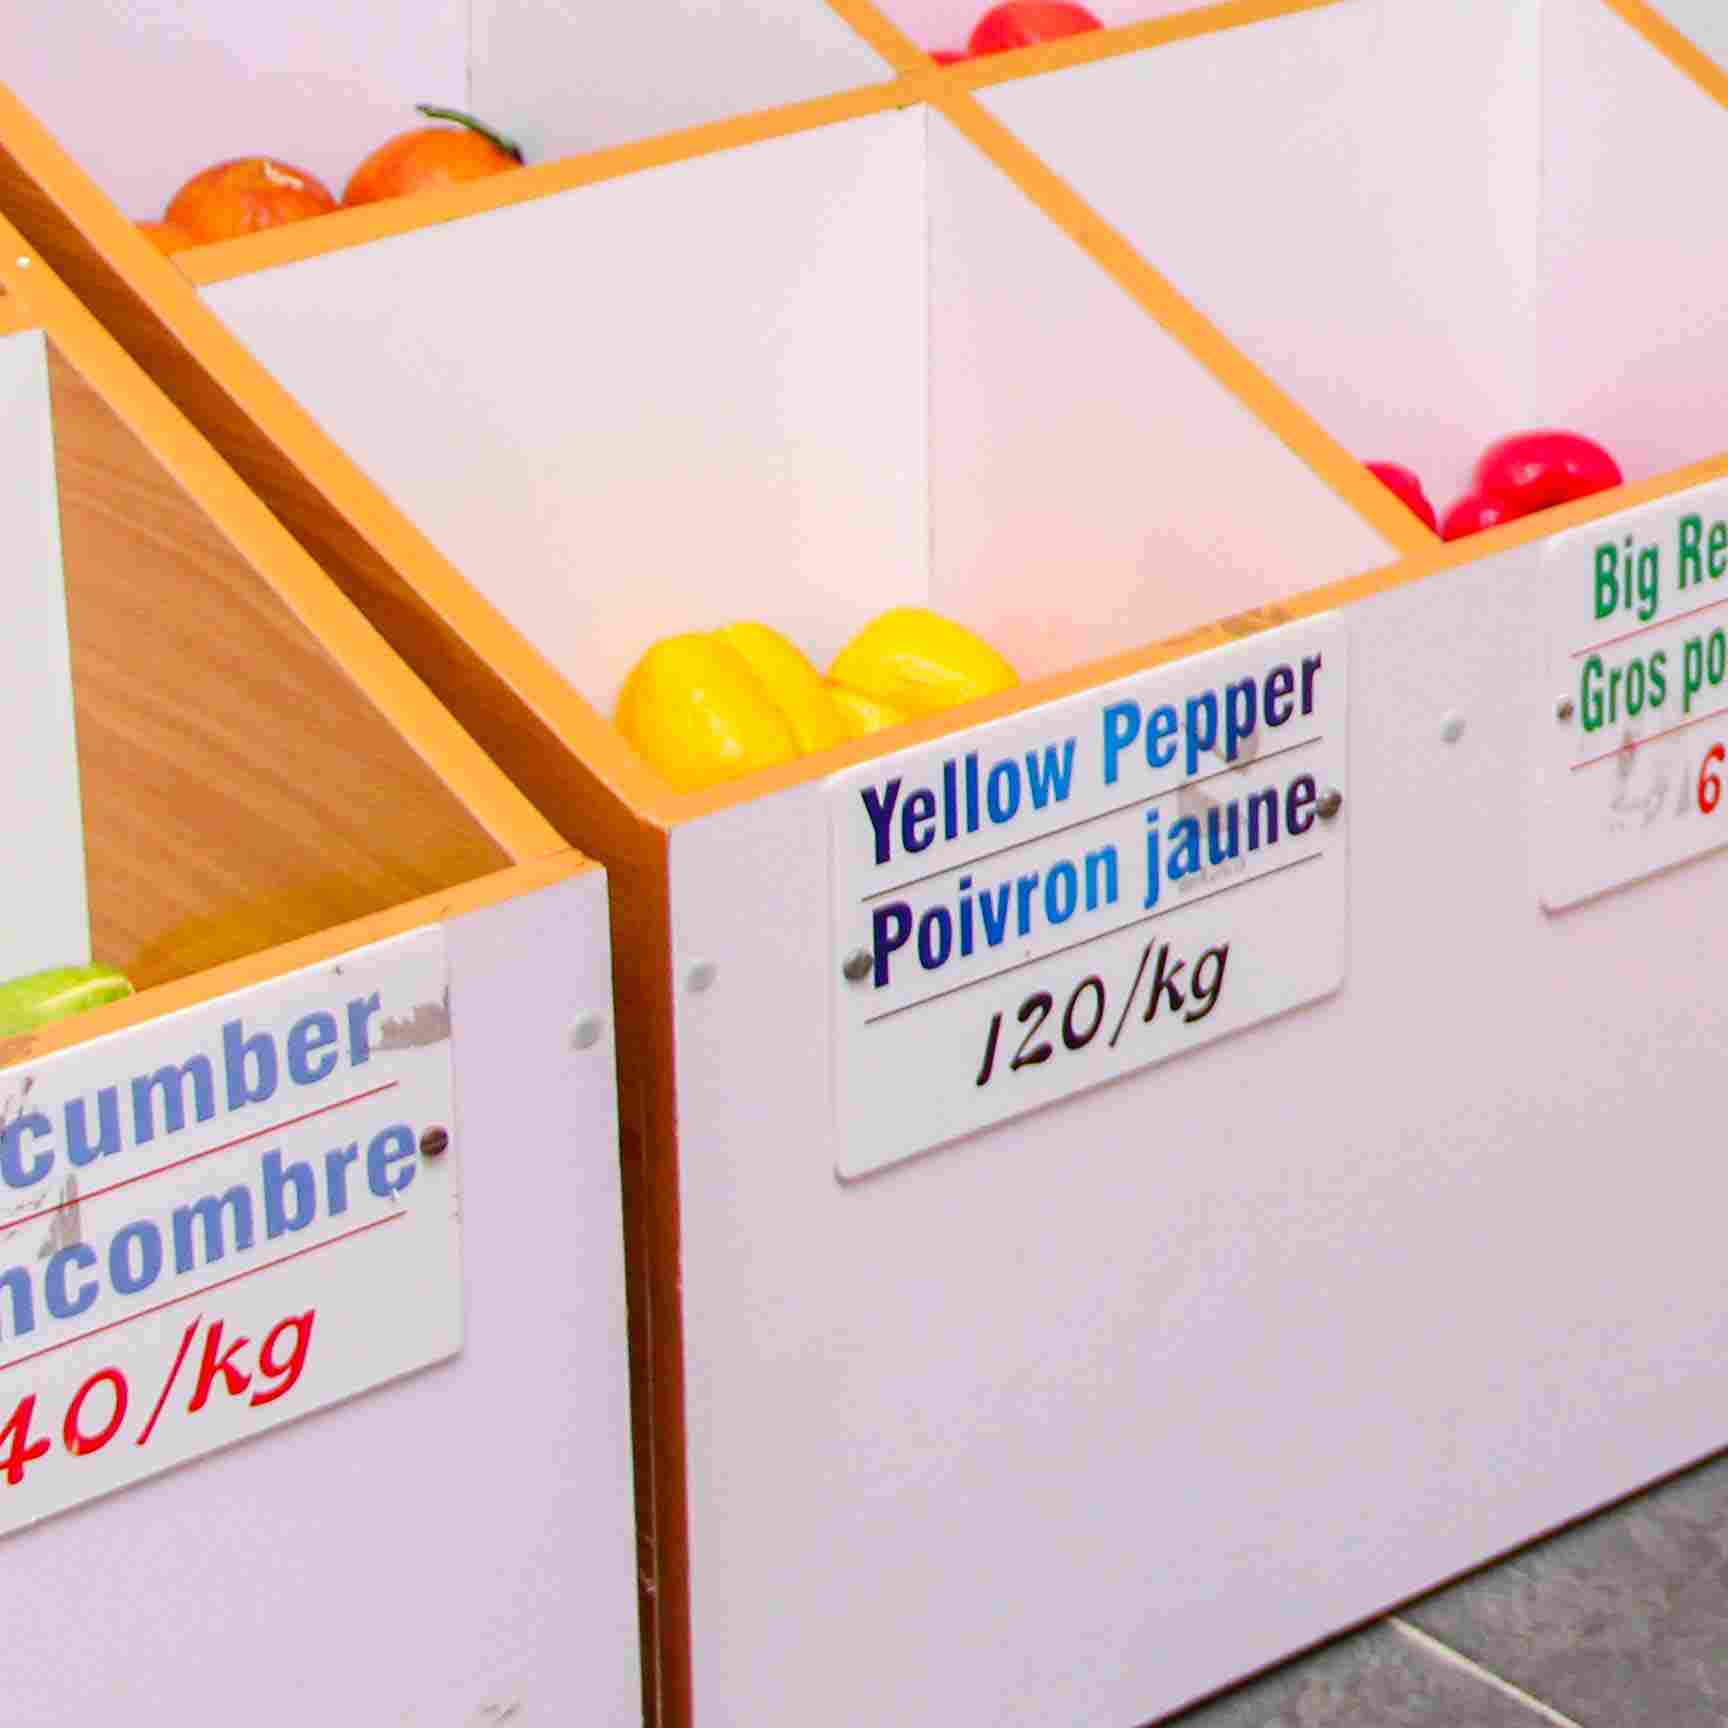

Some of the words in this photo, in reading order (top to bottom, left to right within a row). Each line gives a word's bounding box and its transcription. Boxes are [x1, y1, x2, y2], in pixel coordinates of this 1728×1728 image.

[1593, 535, 1659, 622] Big
[860, 735, 1077, 866] Yellow
[1102, 653, 1321, 785] Pepper
[1580, 649, 1667, 733] Gros
[871, 844, 1119, 990] Poivron
[1144, 772, 1317, 910] jaune
[0, 992, 382, 1190] cumber
[975, 936, 1230, 1087] 120/kg
[0, 1308, 317, 1486] 40/kg
